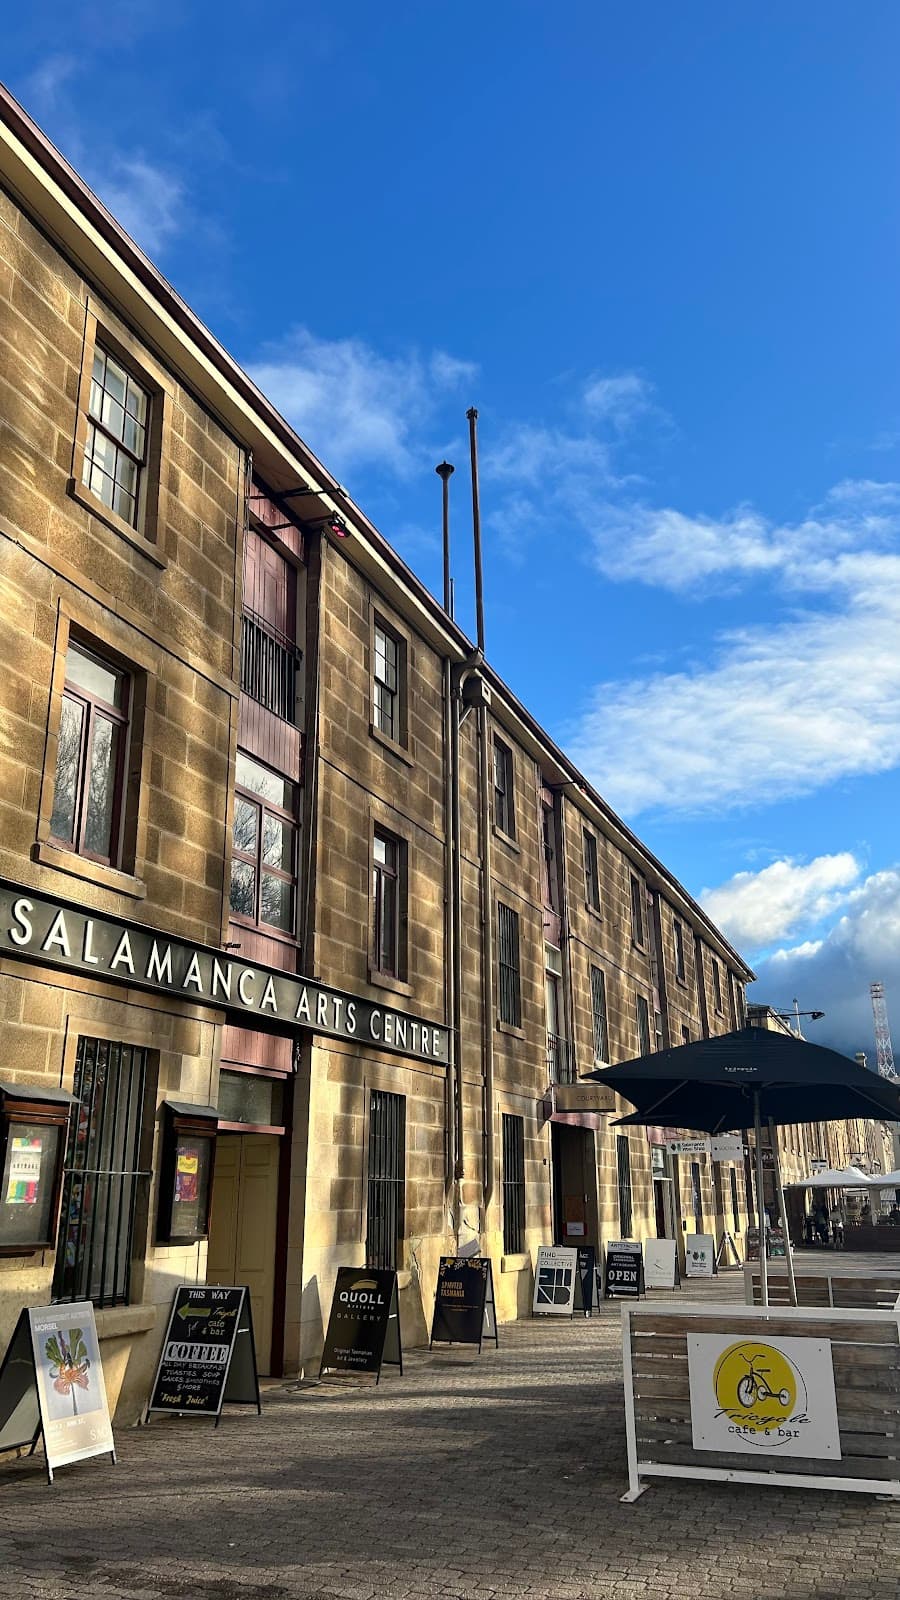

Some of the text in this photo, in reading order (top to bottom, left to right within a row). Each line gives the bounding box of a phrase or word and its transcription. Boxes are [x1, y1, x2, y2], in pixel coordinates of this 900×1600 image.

[9, 898, 441, 1057] SALAMANCA ARTS CENTRE
[608, 1270, 637, 1282] OPEN
[188, 1290, 231, 1300] THIS WAY
[340, 1291, 385, 1305] QUOLL
[336, 1312, 381, 1321] GALLERY
[210, 1328, 225, 1336] bar
[167, 1343, 228, 1363] COFFEE
[713, 1408, 812, 1426] Tricycle
[727, 1423, 801, 1438] cafe & bar
